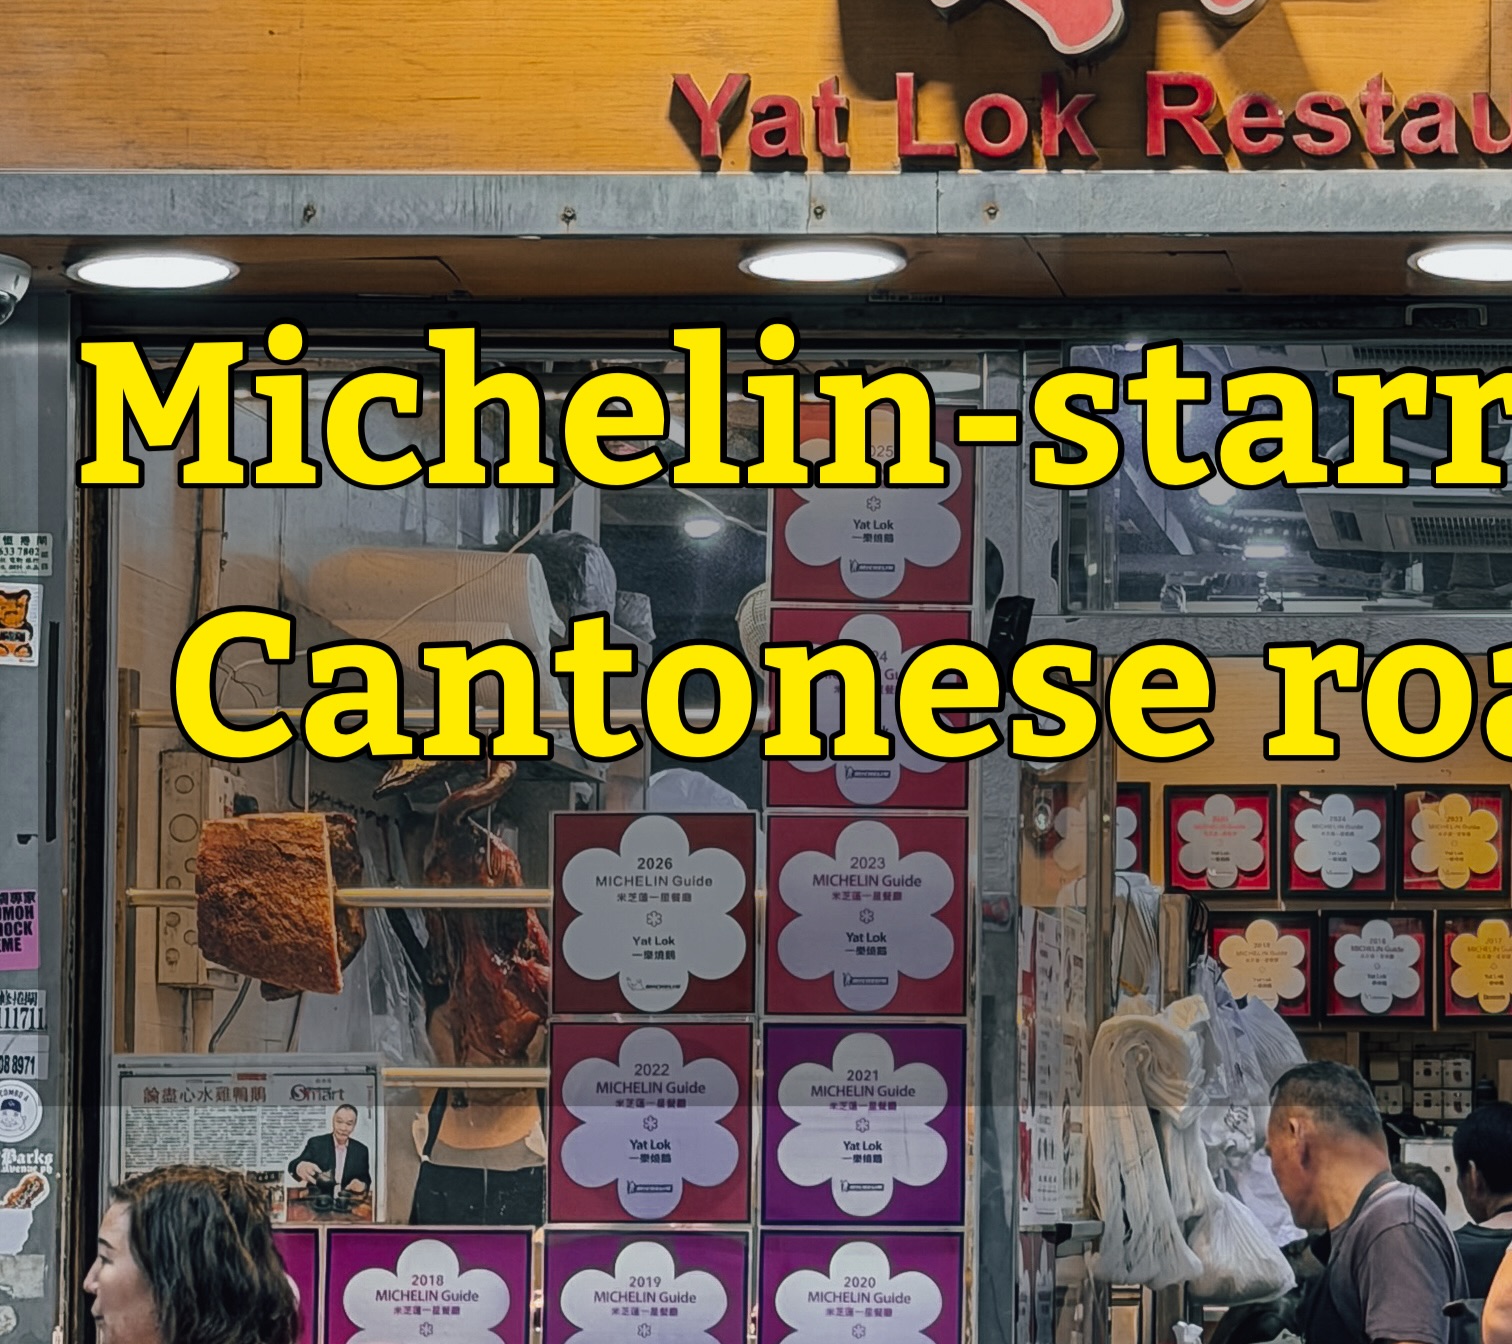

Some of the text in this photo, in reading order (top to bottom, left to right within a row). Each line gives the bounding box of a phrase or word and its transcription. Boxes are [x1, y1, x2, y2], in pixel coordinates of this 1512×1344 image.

[670, 72, 850, 157] Yat
[896, 72, 1098, 157] Lok
[853, 519, 894, 530] Yat Lok
[637, 857, 673, 870] 2026
[850, 857, 885, 869] 2023
[596, 875, 713, 887] MICHELIN Guide
[813, 874, 922, 887] MICHELIN Guide
[633, 936, 675, 946] Yat Lok
[846, 932, 887, 943] Yat Lok
[634, 1064, 670, 1076] 2022
[847, 1070, 879, 1081] 2021
[596, 1082, 706, 1094] MICHELIN Guide
[811, 1085, 915, 1097] MICHELIN Guide
[630, 1139, 671, 1150] Yat Lok
[843, 1140, 882, 1151] Yat Lok
[412, 1275, 444, 1286] 2018
[629, 1276, 661, 1288] 2019
[844, 1276, 876, 1288] 2020
[375, 1290, 479, 1302] MICHELIN Guide
[594, 1292, 696, 1304] MICHELIN Guide
[808, 1292, 911, 1304] MICHELIN Guide
